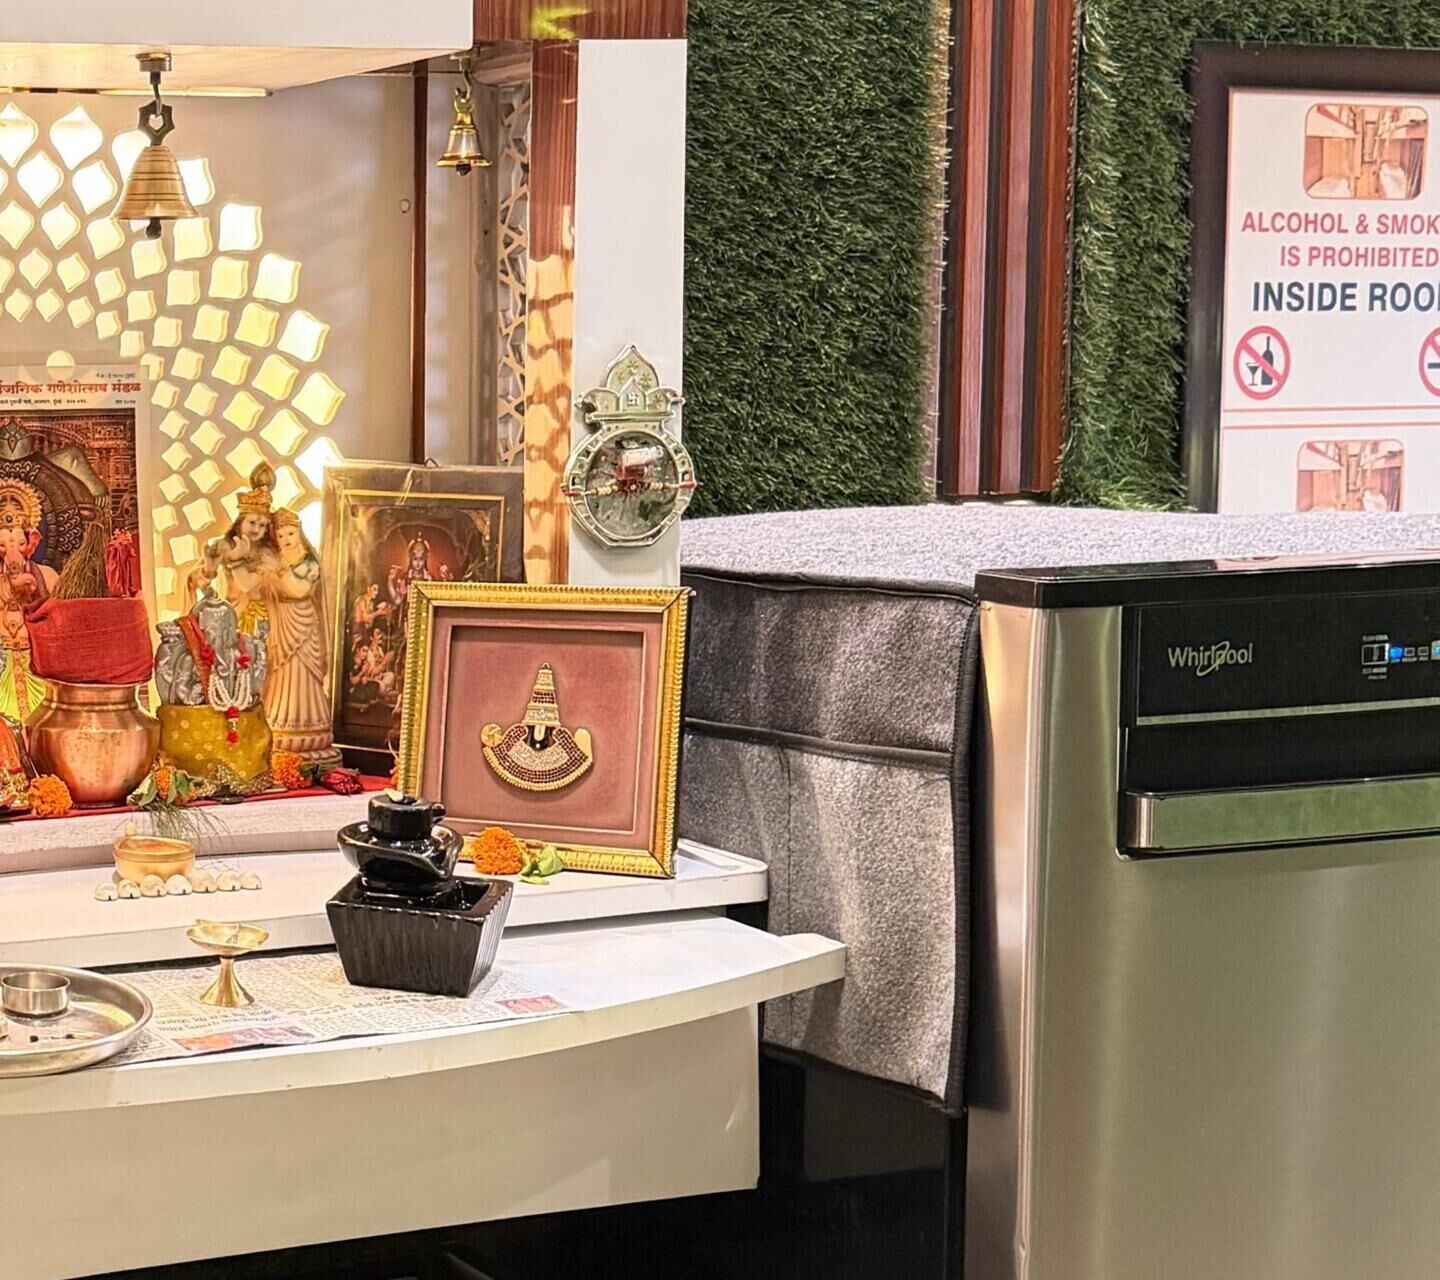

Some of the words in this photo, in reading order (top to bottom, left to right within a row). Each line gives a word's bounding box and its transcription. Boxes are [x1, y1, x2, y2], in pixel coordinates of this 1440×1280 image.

[1241, 212, 1349, 234] ALCOHOL
[1355, 214, 1369, 234] &
[1280, 246, 1301, 267] IS
[1307, 246, 1439, 268] PROHIBITED
[1253, 281, 1358, 312] INSIDE
[1368, 282, 1440, 313] ROO
[1168, 641, 1253, 676] Whirlpool
